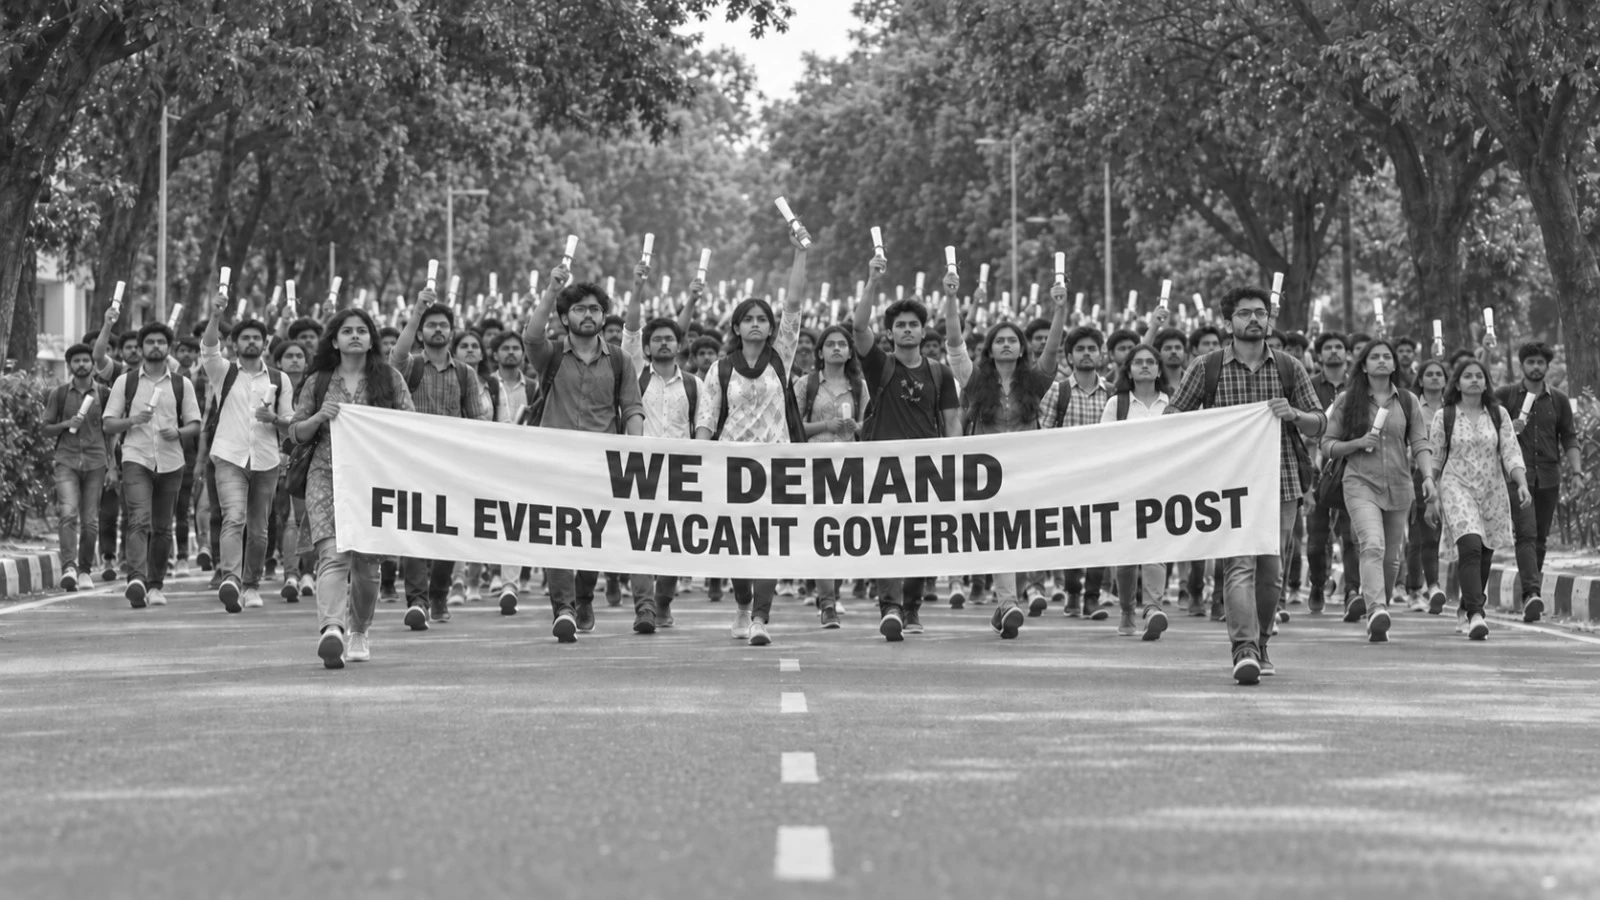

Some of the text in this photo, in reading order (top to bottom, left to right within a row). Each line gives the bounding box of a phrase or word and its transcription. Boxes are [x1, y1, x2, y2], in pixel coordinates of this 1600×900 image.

[605, 450, 1003, 505] WE DEMAND
[371, 486, 1249, 557] FILL EVERY VACANT GOVERNMENT POST
